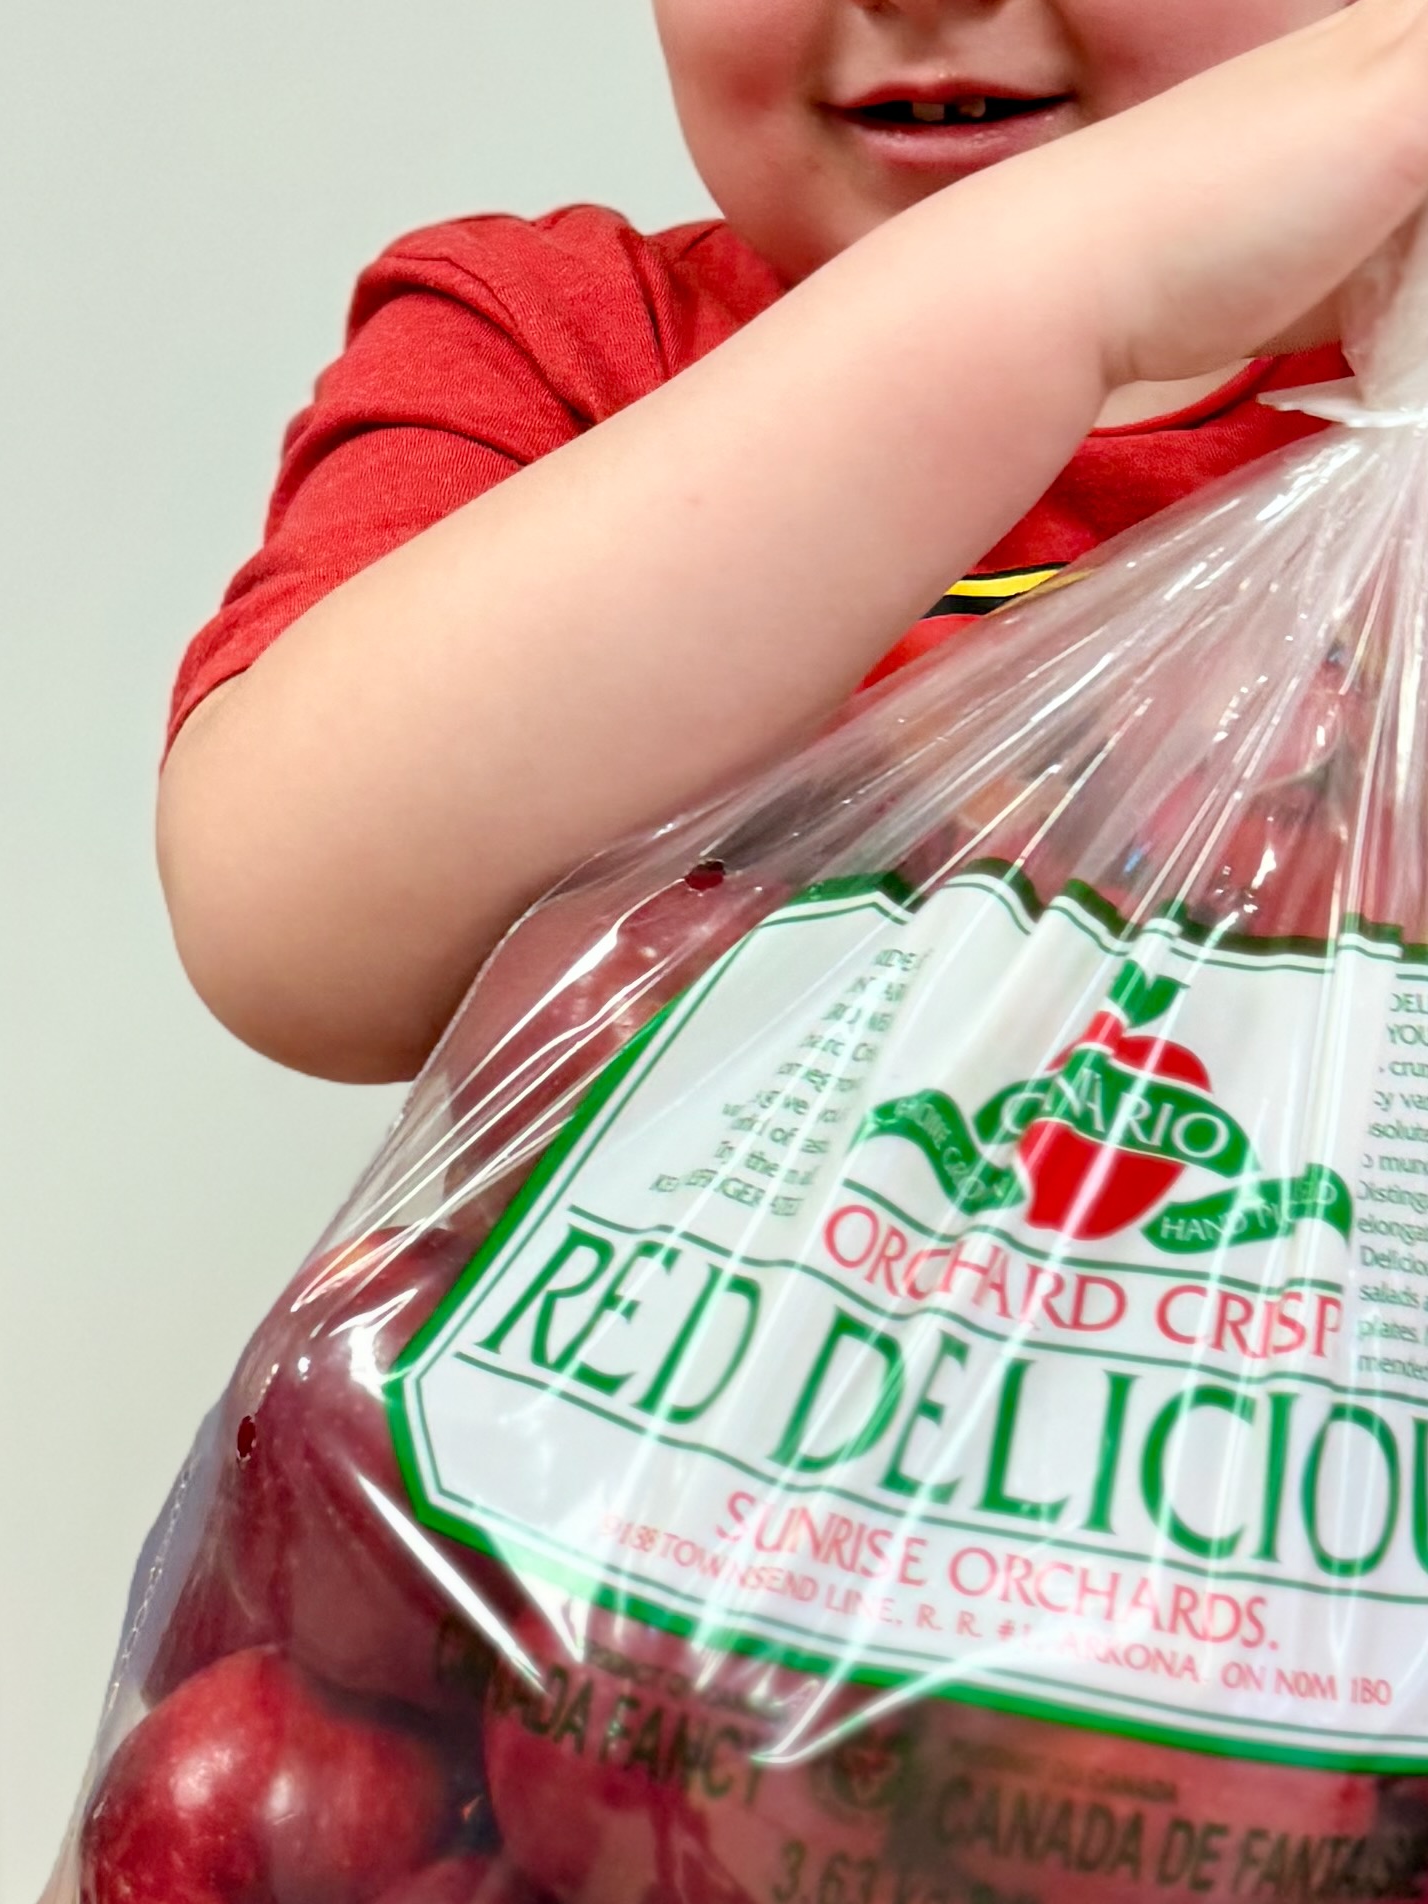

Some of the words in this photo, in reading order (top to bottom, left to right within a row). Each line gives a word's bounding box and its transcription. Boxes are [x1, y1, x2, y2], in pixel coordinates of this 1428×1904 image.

[475, 1224, 763, 1426] RED
[824, 1204, 1127, 1331] ORCHARD
[1155, 1283, 1344, 1358] CRISP
[659, 1531, 819, 1603] TOWNSEND
[1220, 1660, 1267, 1693] ON
[715, 1491, 930, 1588] SUNRISE
[948, 1546, 1280, 1651] ORCHARDS.
[929, 1775, 1145, 1888] CANADA
[1156, 1816, 1231, 1896] DE
